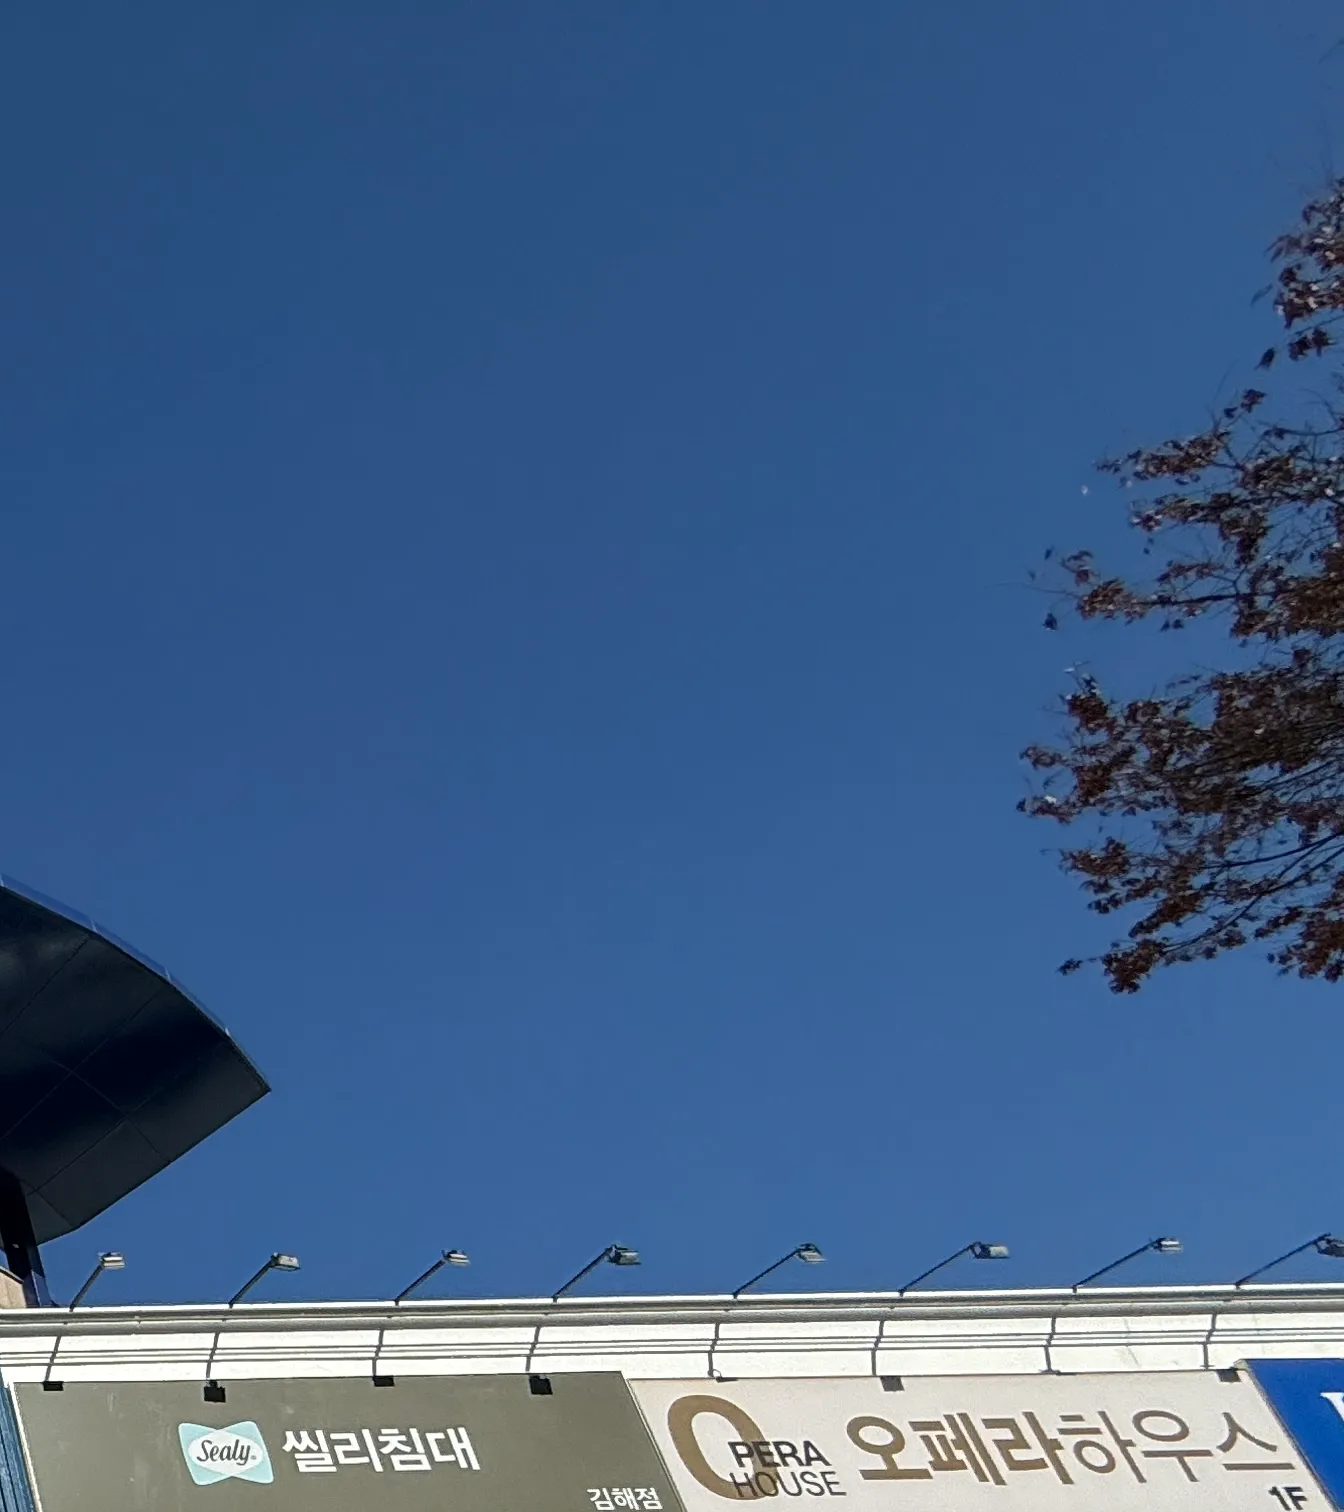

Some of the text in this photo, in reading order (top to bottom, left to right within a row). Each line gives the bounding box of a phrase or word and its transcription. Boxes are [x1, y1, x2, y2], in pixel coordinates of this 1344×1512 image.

[196, 1439, 251, 1466] Sealy
[282, 1426, 481, 1474] 씰리침대
[846, 1409, 1296, 1485] 오페라하우스
[729, 1471, 847, 1497] HOUSE
[586, 1486, 663, 1512] 김해점
[1268, 1486, 1308, 1511] 1F
